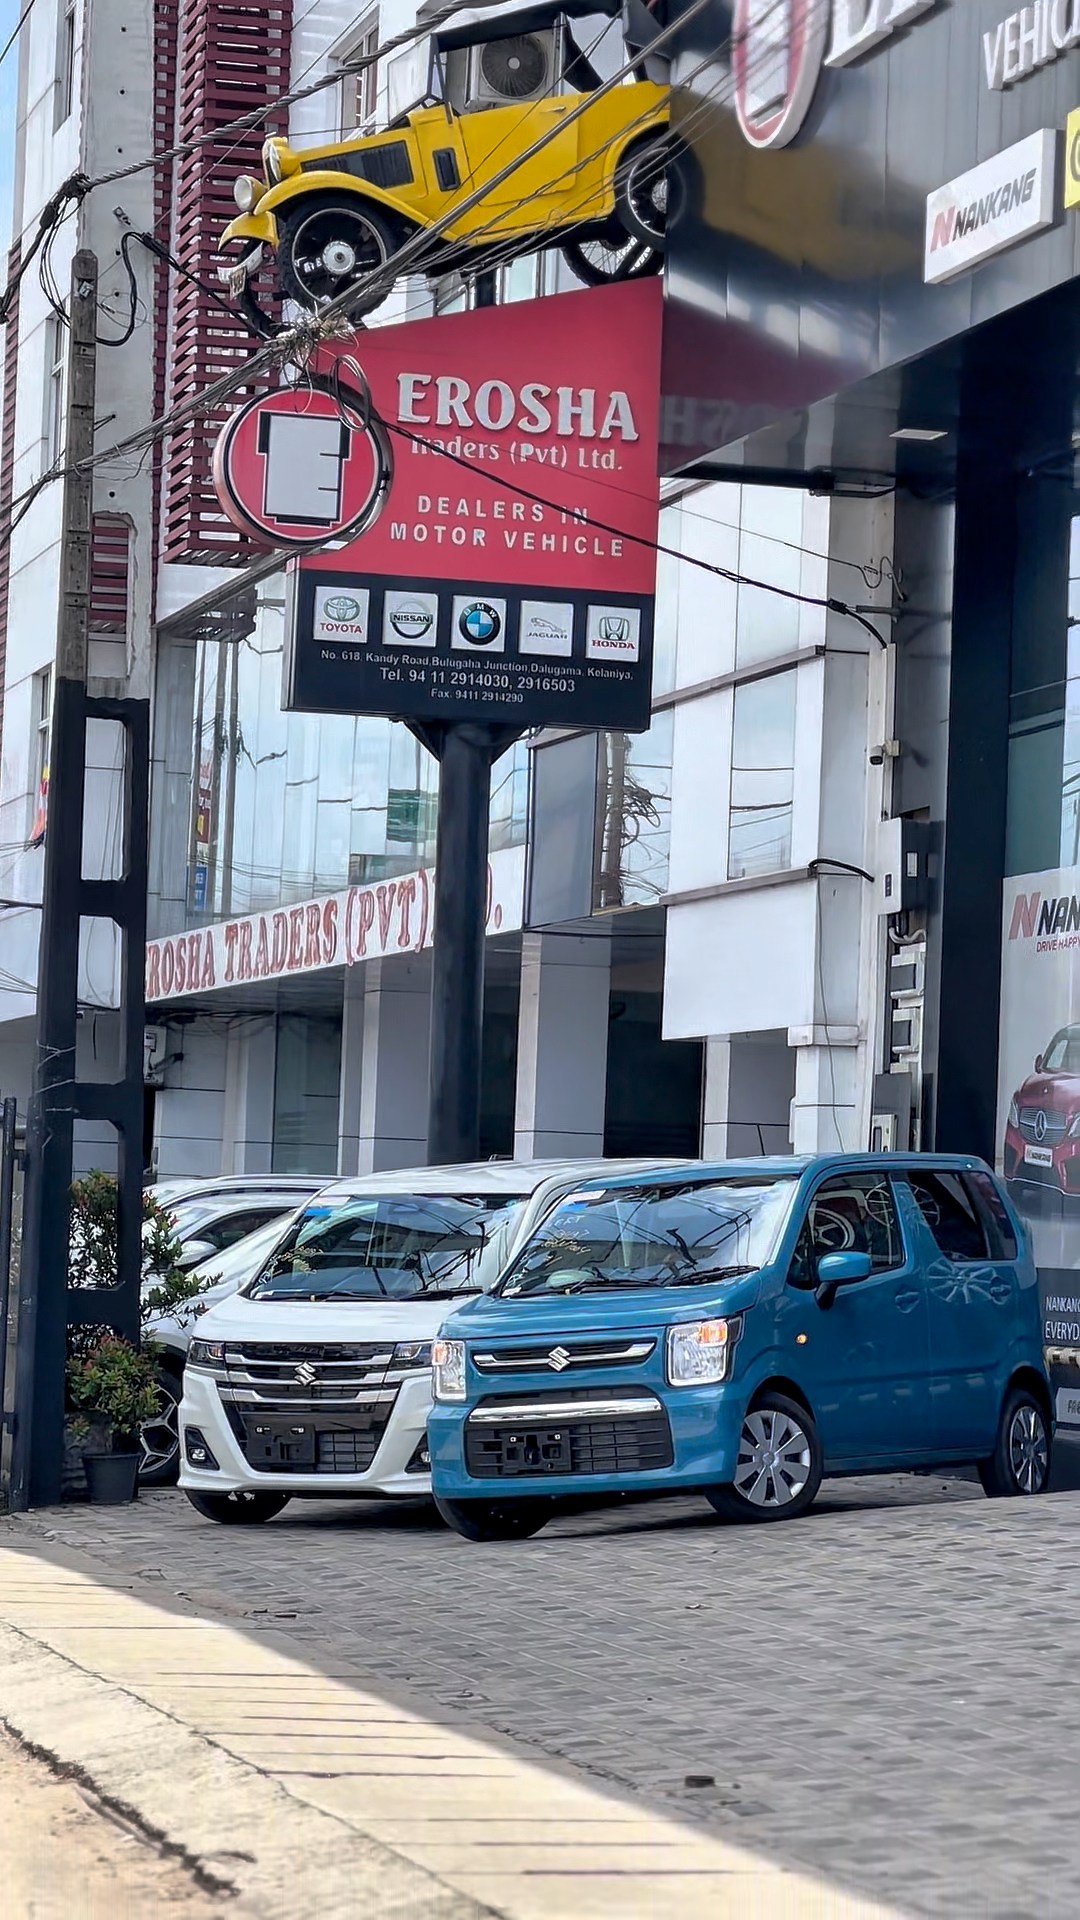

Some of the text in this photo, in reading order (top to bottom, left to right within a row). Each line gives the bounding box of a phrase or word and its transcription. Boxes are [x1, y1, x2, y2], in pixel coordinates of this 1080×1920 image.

[951, 167, 1037, 242] NANKANG
[397, 372, 640, 442] EROSHA
[411, 433, 624, 471] Traders (Pvt) Ltd.
[417, 494, 589, 526] DEALERS IN
[390, 522, 624, 558] MOTOR VEHICLE
[319, 622, 363, 634] TOYOTA
[393, 614, 431, 623] NISSAN
[526, 631, 568, 640] JAGUAR
[591, 639, 636, 650] HONDA
[365, 652, 400, 666] Kandy
[380, 666, 576, 693] Tel. 94 11 2914030, 2916503
[481, 691, 524, 704] 2914290
[146, 929, 216, 999] ROSHA
[224, 898, 339, 983] TRADERS
[344, 866, 430, 968] (PVT)
[1036, 939, 1058, 953] DRIVE
[1045, 1320, 1080, 1341] EVERYD
